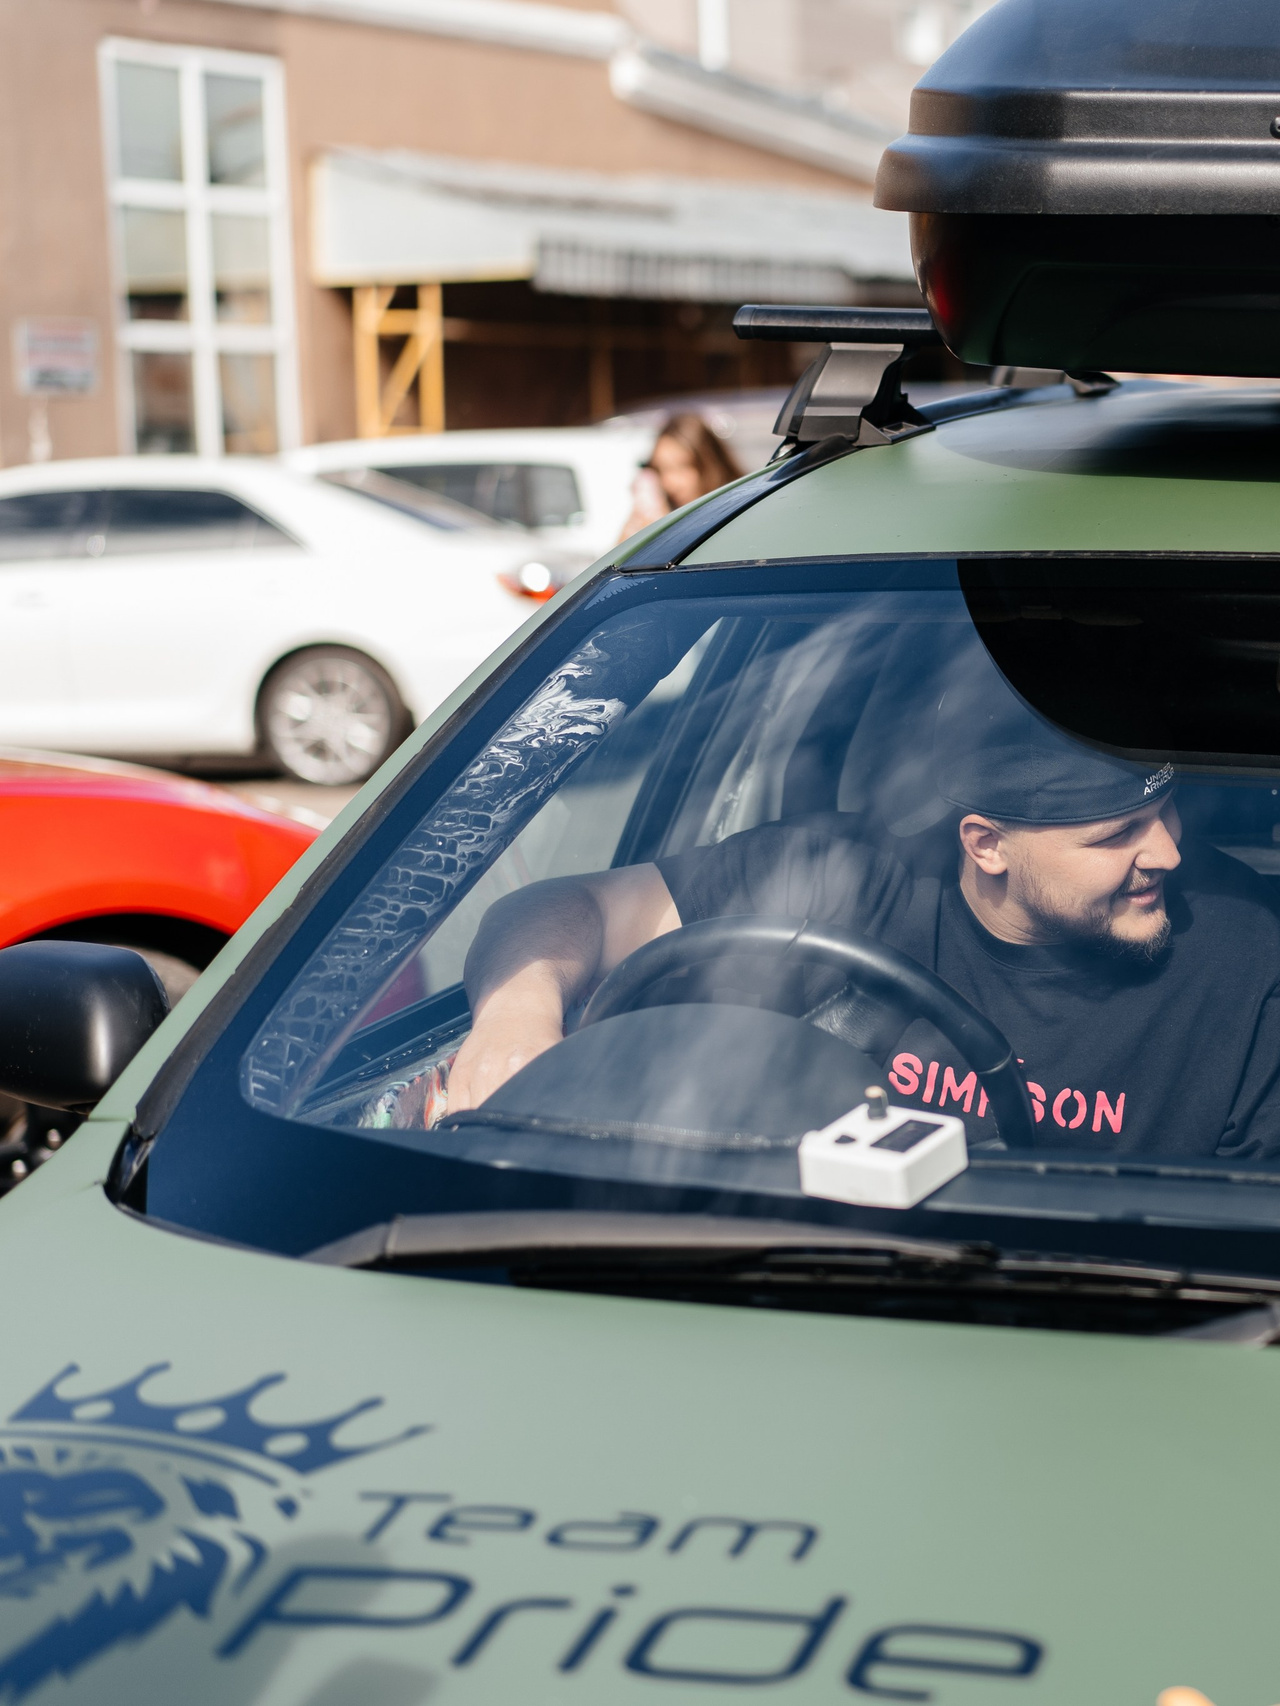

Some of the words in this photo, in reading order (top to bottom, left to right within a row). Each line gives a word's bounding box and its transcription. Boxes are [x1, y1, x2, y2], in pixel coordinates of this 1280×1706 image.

[1143, 766, 1175, 796] ARMOUR
[358, 1491, 818, 1562] Team
[213, 1564, 1046, 1703] Pride
